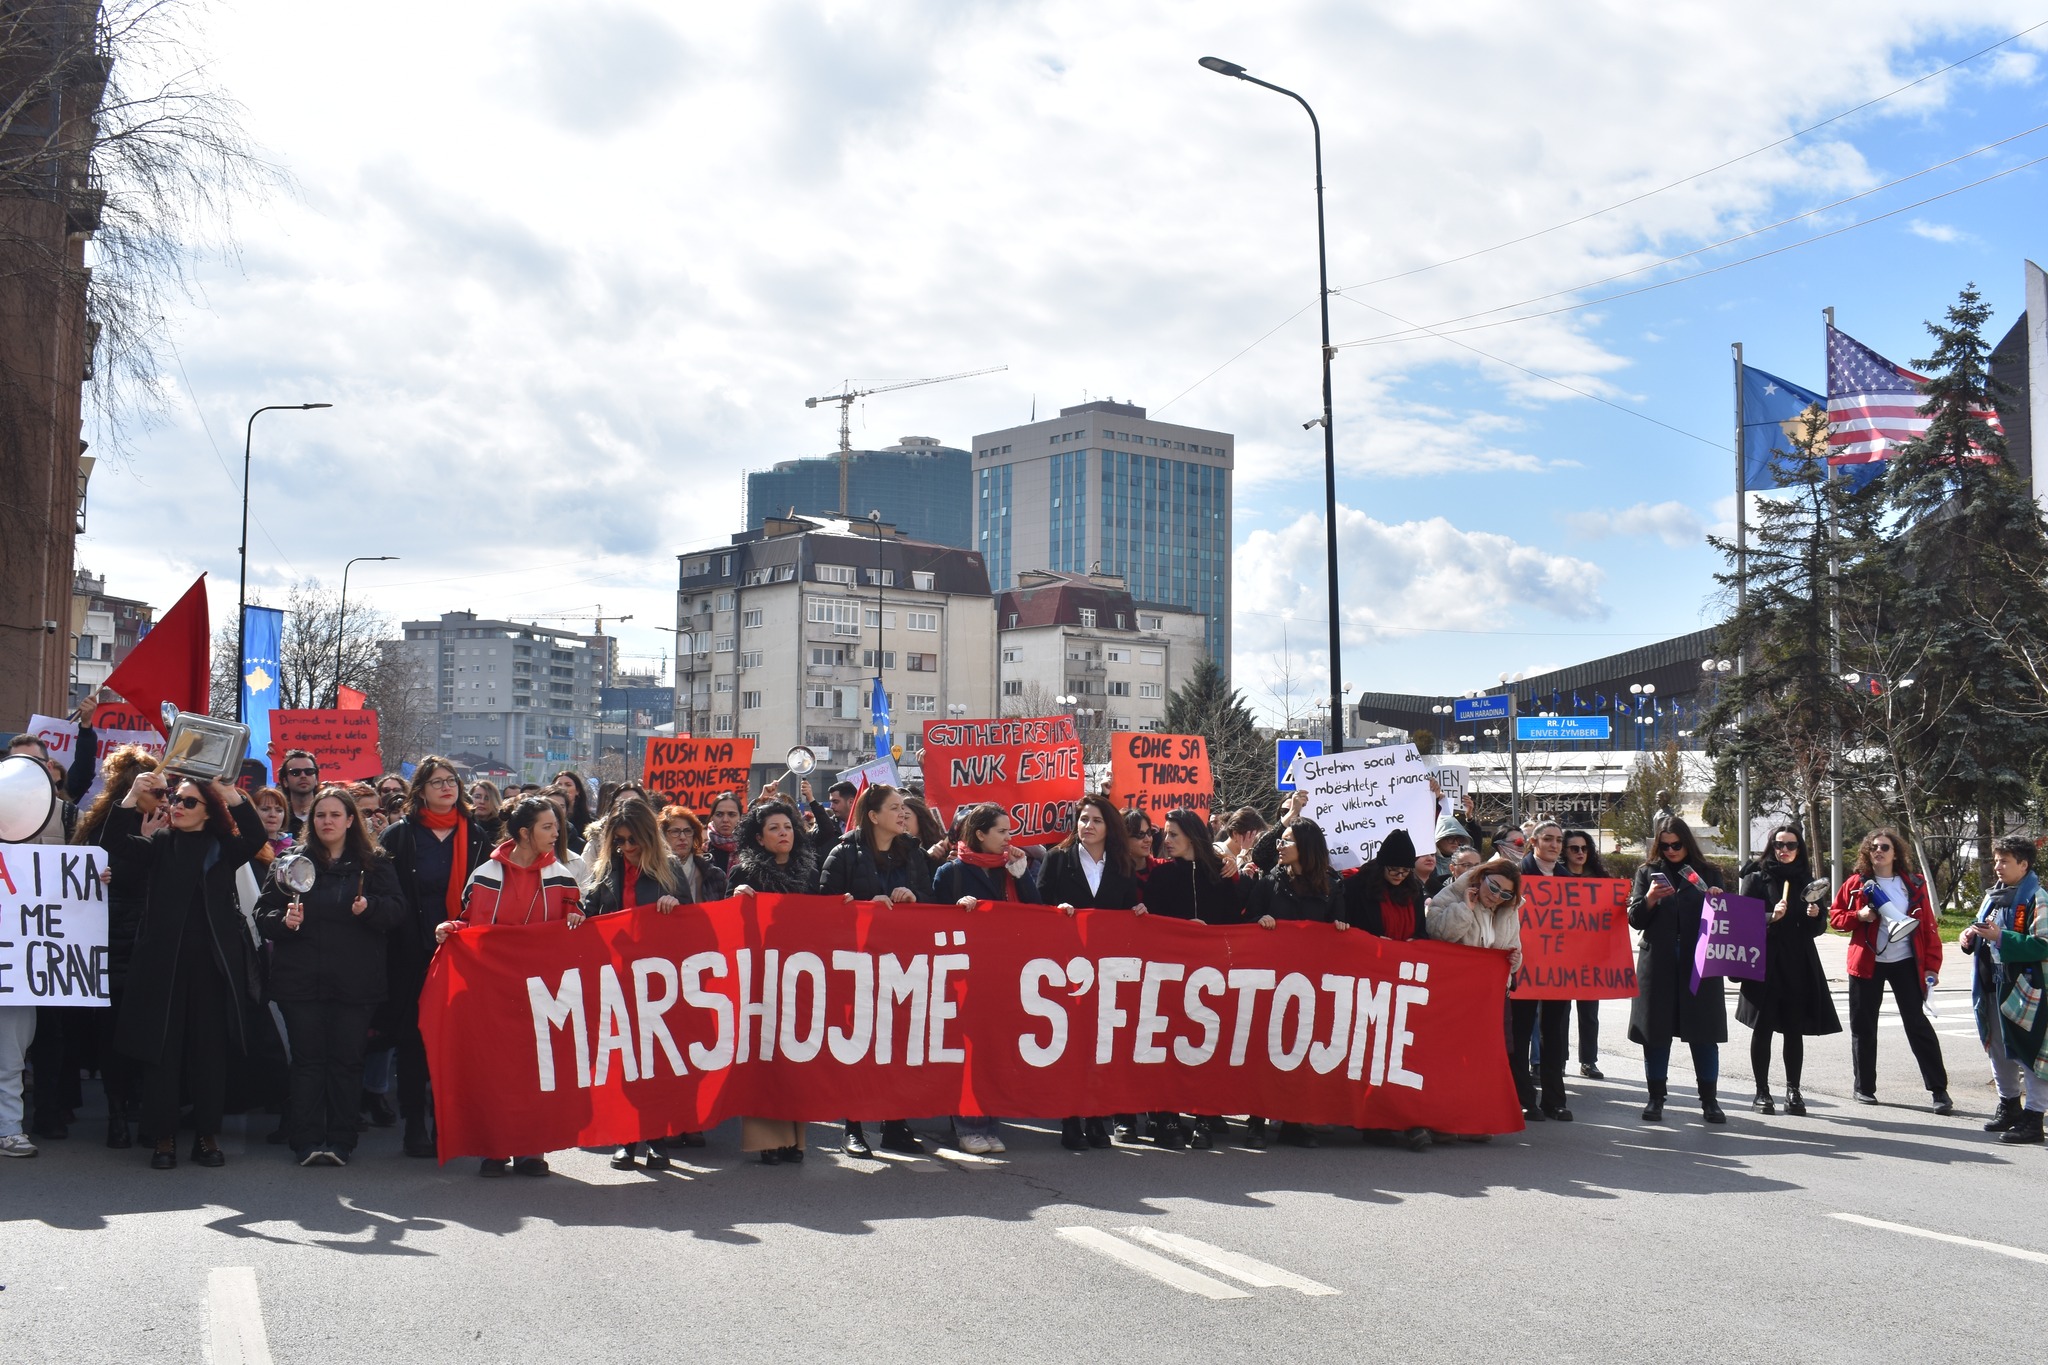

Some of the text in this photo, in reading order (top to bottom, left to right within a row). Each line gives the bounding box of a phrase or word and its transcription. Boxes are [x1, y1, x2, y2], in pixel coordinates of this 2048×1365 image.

[1460, 708, 1505, 719] LUAN HARADINAJ
[1471, 700, 1480, 708] RR.
[344, 714, 371, 726] kusht
[280, 733, 289, 741] e
[1530, 728, 1599, 737] ENVER ZYMBERI
[653, 742, 733, 766] KUSH NA
[1129, 736, 1200, 760] EDHE SA
[950, 744, 1079, 787] NUK ËSHTË
[1137, 763, 1198, 785] THIRRJE
[1303, 759, 1355, 781] Strehim
[1363, 752, 1396, 770] social
[648, 765, 719, 791] MBRONË
[1315, 777, 1380, 797] mbështetje
[1124, 790, 1149, 811] TË
[1316, 795, 1388, 819] për viktimat
[1535, 800, 1607, 812] LIFESTYLE
[1009, 800, 1078, 837] SLLOGA
[1335, 817, 1376, 834] dhunës
[1386, 813, 1405, 825] me
[1329, 839, 1382, 861] azë gjin
[33, 852, 42, 897] I
[61, 852, 103, 902] KA
[1522, 880, 1602, 907] ASJET
[1710, 898, 1728, 912] SA
[20, 904, 65, 939] ME
[1540, 932, 1565, 955] TË
[1706, 943, 1761, 968] BURA?
[26, 940, 111, 999] GRAVE
[1517, 964, 1636, 989] ALAJMËRUAR
[526, 931, 1430, 1092] MARSHOJMË S'FESTOJMË
